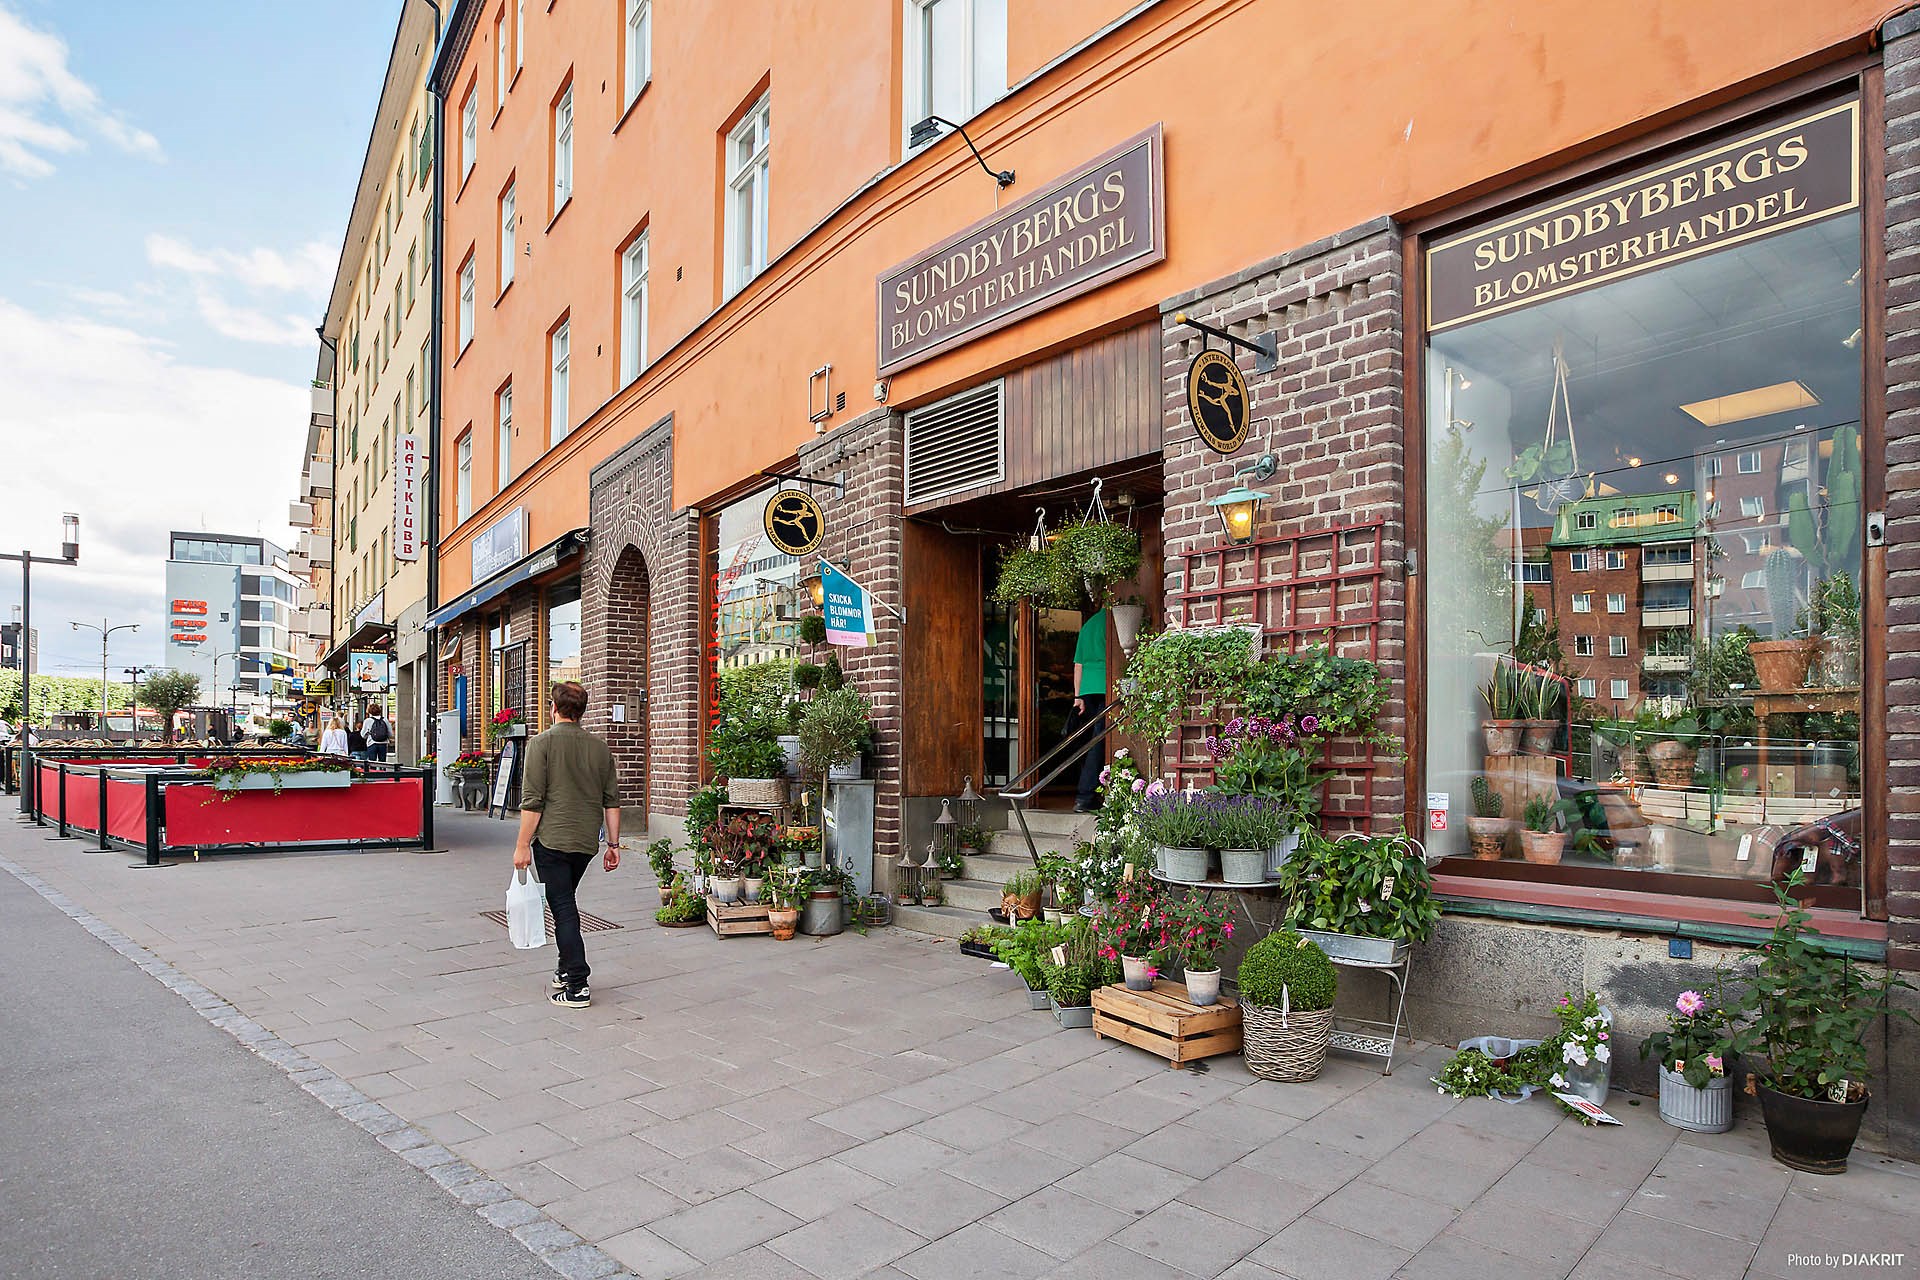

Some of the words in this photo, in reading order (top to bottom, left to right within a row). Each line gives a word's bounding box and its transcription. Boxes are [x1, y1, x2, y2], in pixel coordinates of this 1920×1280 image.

[1474, 135, 1809, 271] SUNDBYBERGS
[894, 169, 1126, 315] SUNDBYBERGS
[1474, 187, 1808, 308] BLOMSTERHANDEL
[891, 216, 1136, 350] BLOMSTERHANDEL
[1201, 353, 1239, 378] INTERFLORA
[1193, 406, 1216, 445] FLOWERS
[1217, 440, 1238, 451] WORLD
[403, 439, 415, 554] NATTKLUBB
[777, 491, 813, 505] INTERFLORA
[767, 526, 790, 552] FLOWERS
[790, 545, 811, 554] WORLD
[828, 593, 853, 606] SKICKA
[829, 605, 862, 618] BLOMMOR
[830, 616, 847, 628] HÄR!
